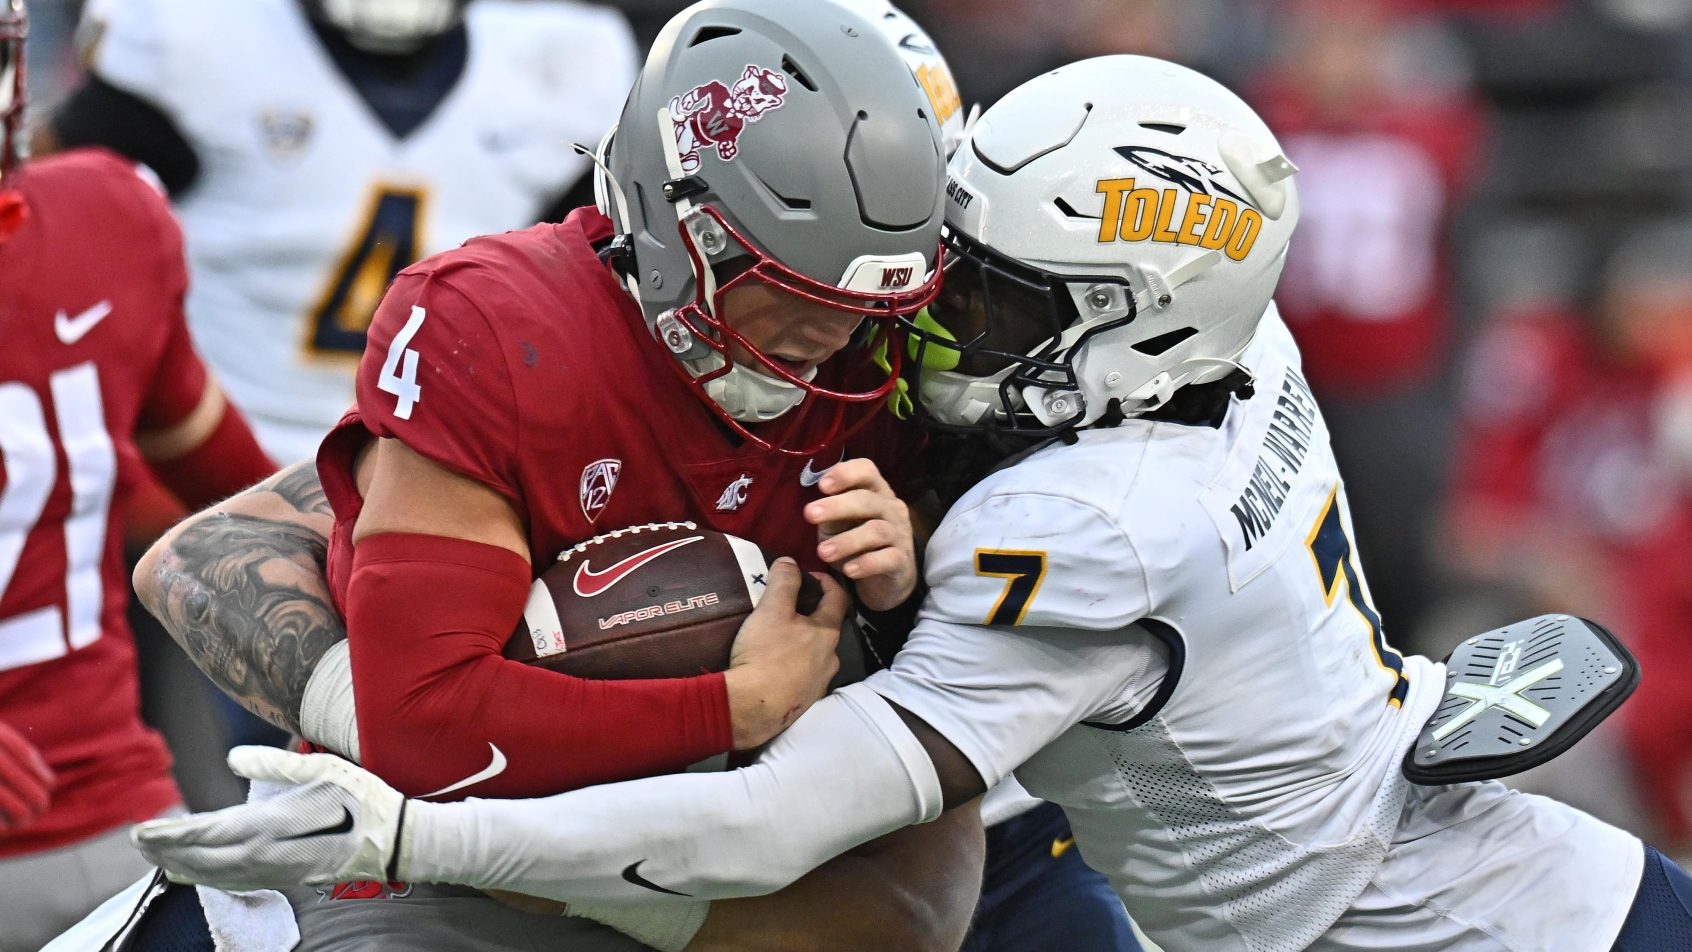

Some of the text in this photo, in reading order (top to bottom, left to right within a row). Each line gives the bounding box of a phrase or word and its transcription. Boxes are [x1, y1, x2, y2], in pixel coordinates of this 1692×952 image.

[706, 111, 730, 136] W
[954, 187, 973, 209] CITY
[1095, 177, 1263, 262] TOLEDO
[303, 181, 428, 360] 4
[880, 267, 913, 287] WSU
[377, 304, 422, 420] 4
[583, 462, 618, 496] PAC
[586, 486, 606, 510] 12
[974, 547, 1047, 626] 7
[598, 592, 719, 630] VAPOR ELITE
